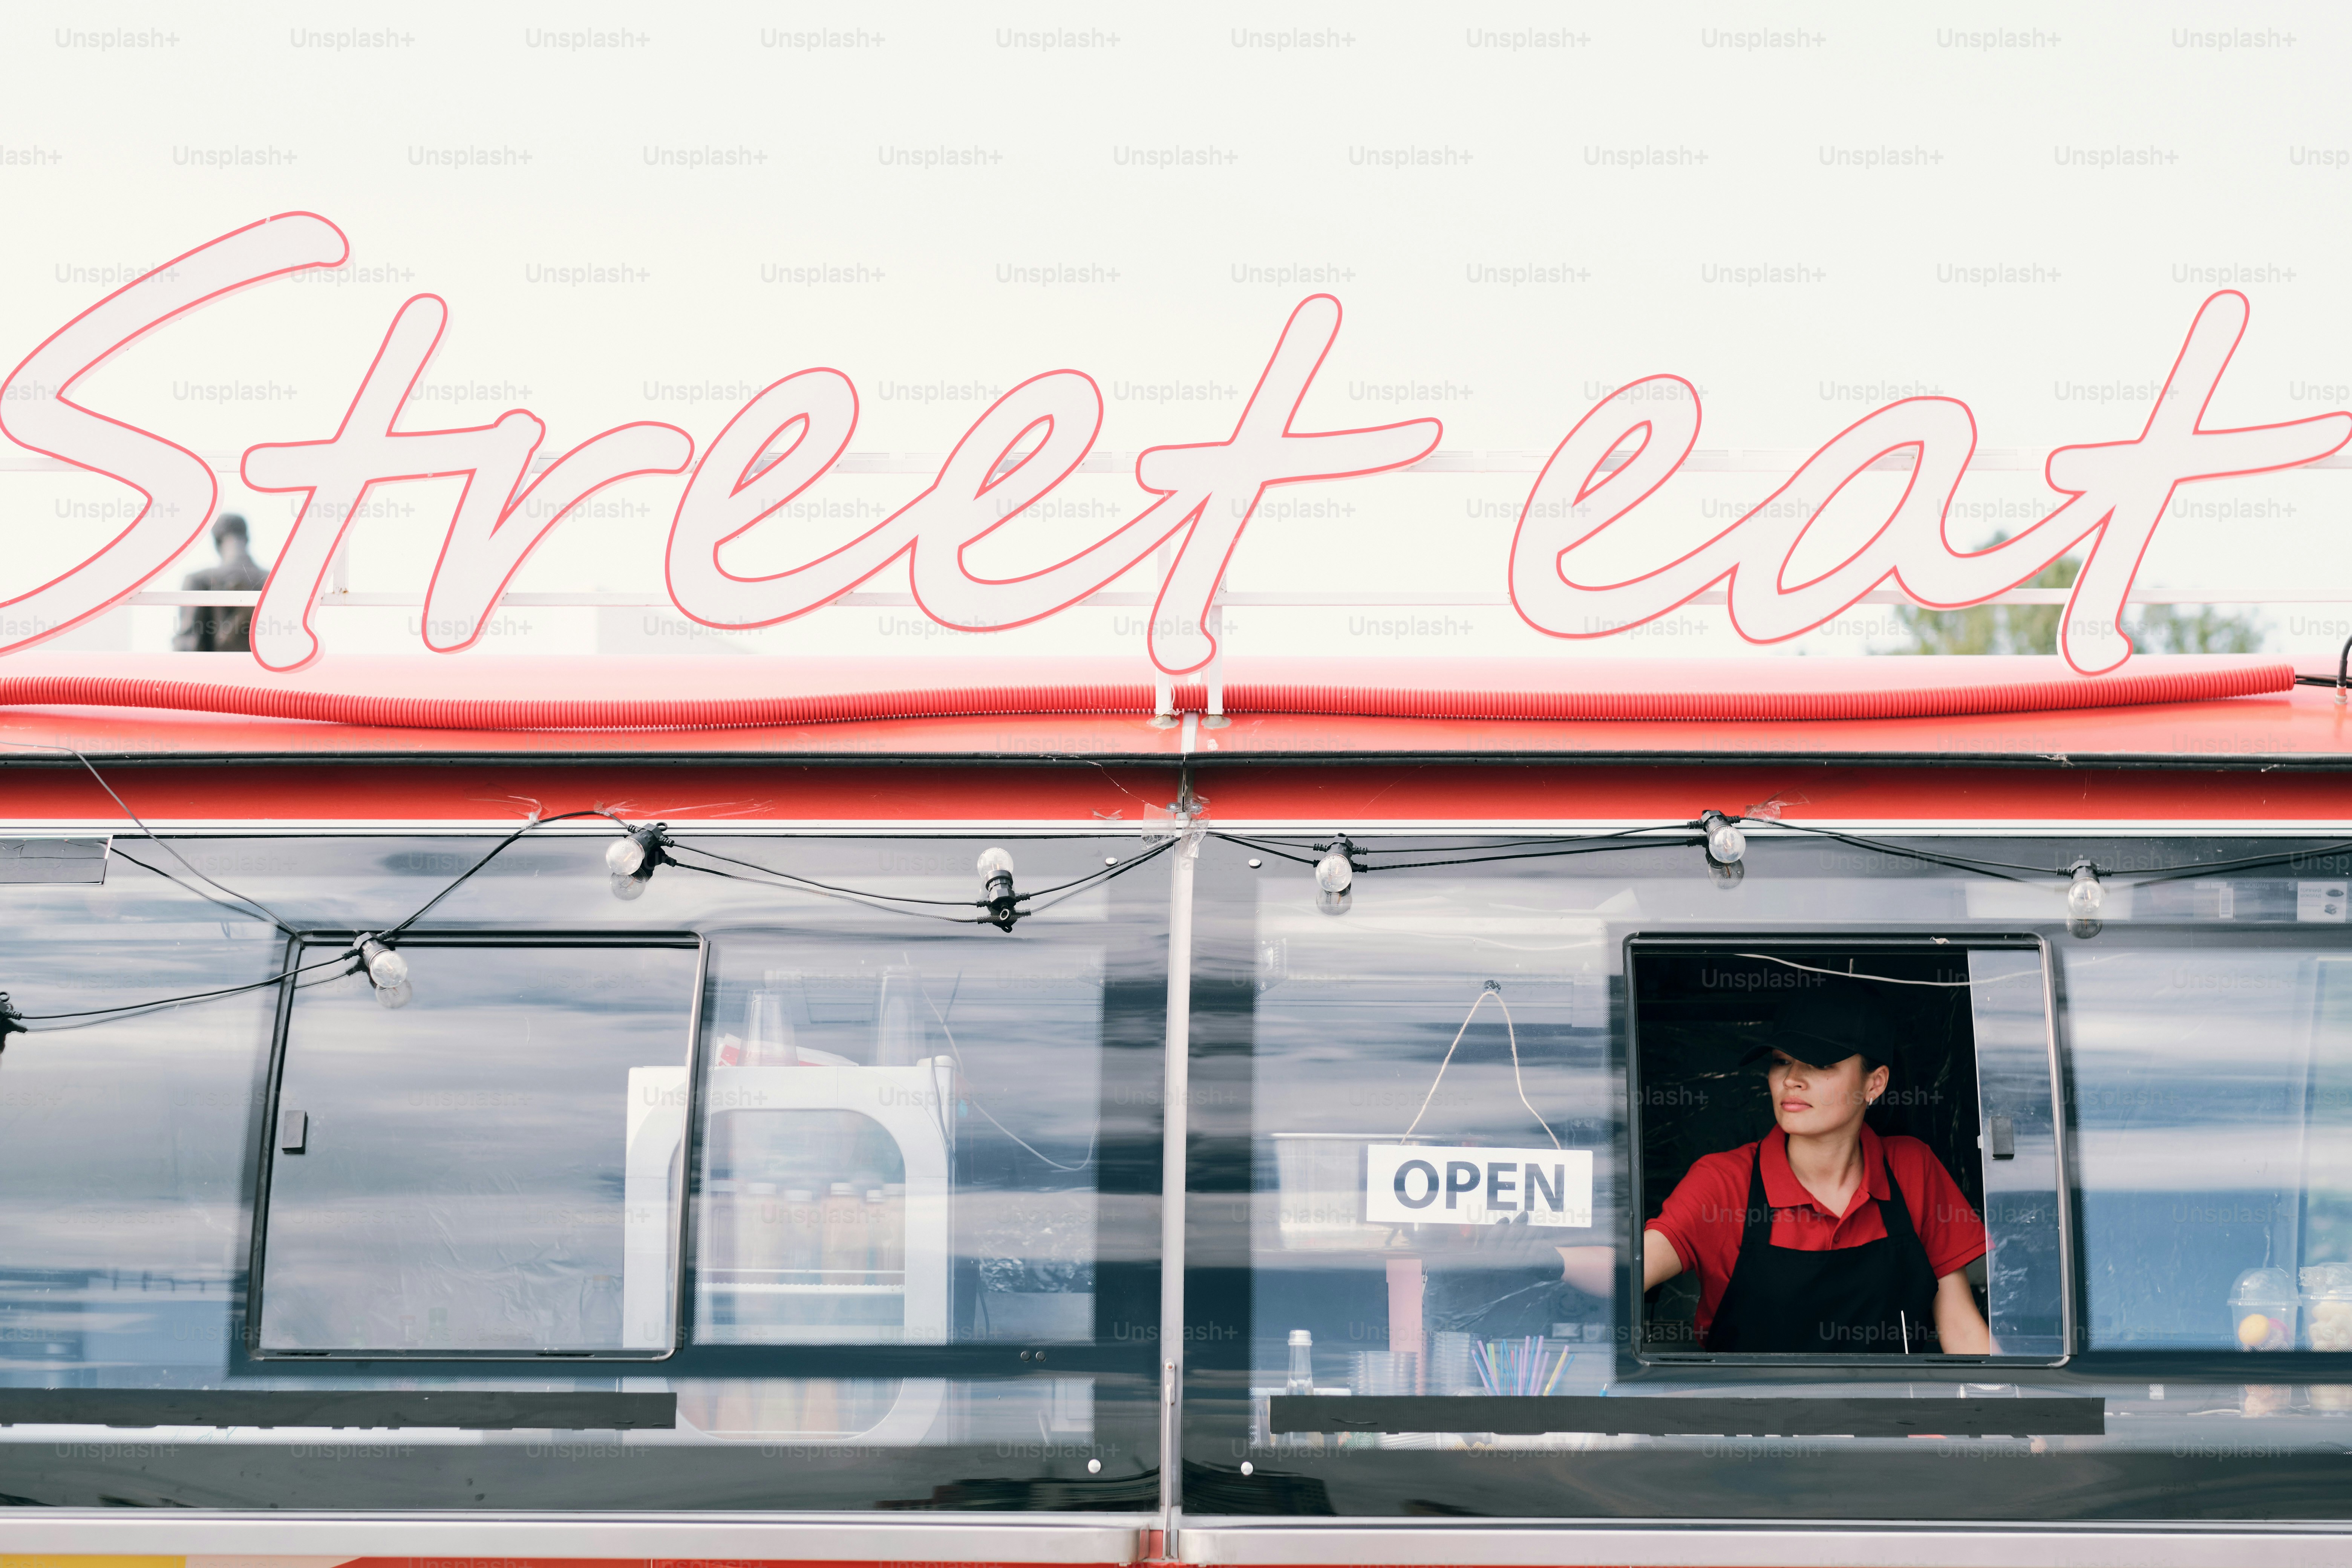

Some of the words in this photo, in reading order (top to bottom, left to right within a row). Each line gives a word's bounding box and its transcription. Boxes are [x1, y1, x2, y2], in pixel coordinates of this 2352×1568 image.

[0, 211, 1443, 675] Street
[1508, 289, 2352, 677] eat
[1393, 1159, 1565, 1212] OPEN
